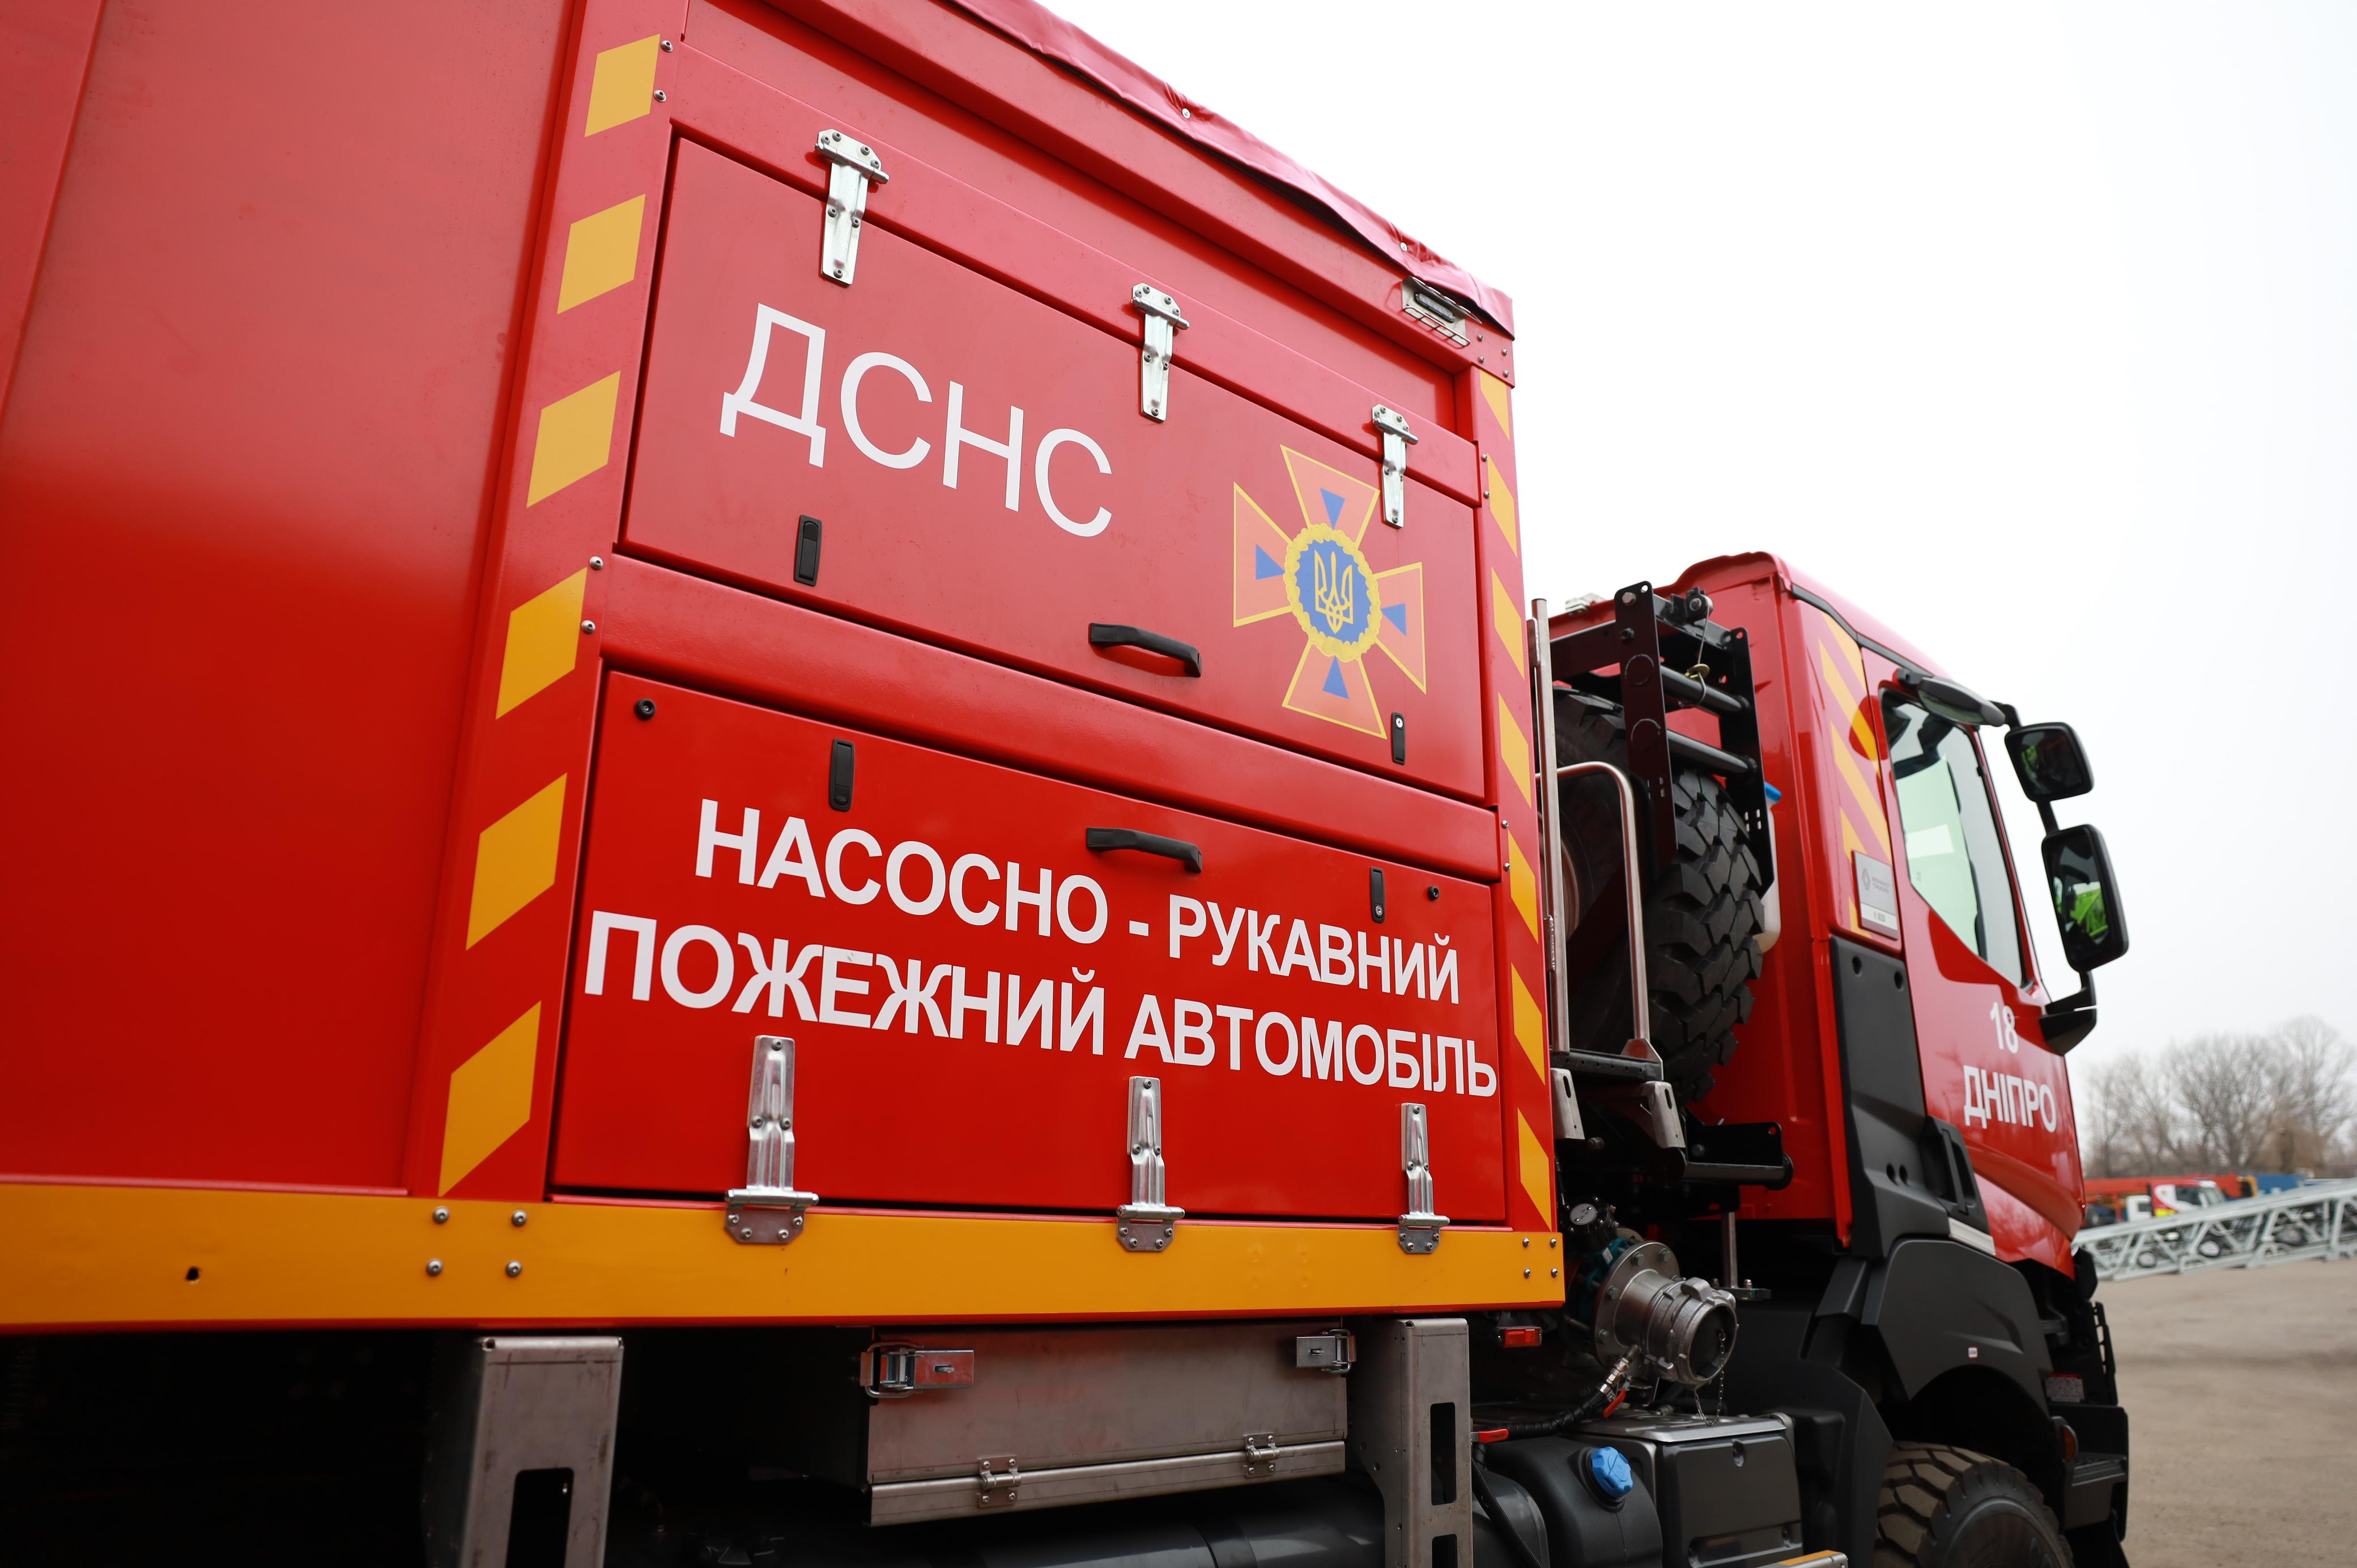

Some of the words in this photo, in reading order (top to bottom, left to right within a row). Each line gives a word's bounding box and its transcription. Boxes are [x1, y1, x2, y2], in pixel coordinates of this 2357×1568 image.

[720, 302, 1112, 537] ДСНС
[695, 798, 1108, 944] НАСОСНО
[1169, 894, 1459, 1004] РУКАВНИЙ
[585, 910, 1104, 1055] ПОЖЕЖНИЙ
[1124, 994, 1497, 1097] АВТОМОБІЛЬ
[1989, 1001, 2020, 1054] 18
[1963, 1064, 2057, 1133] ДНІПРО
